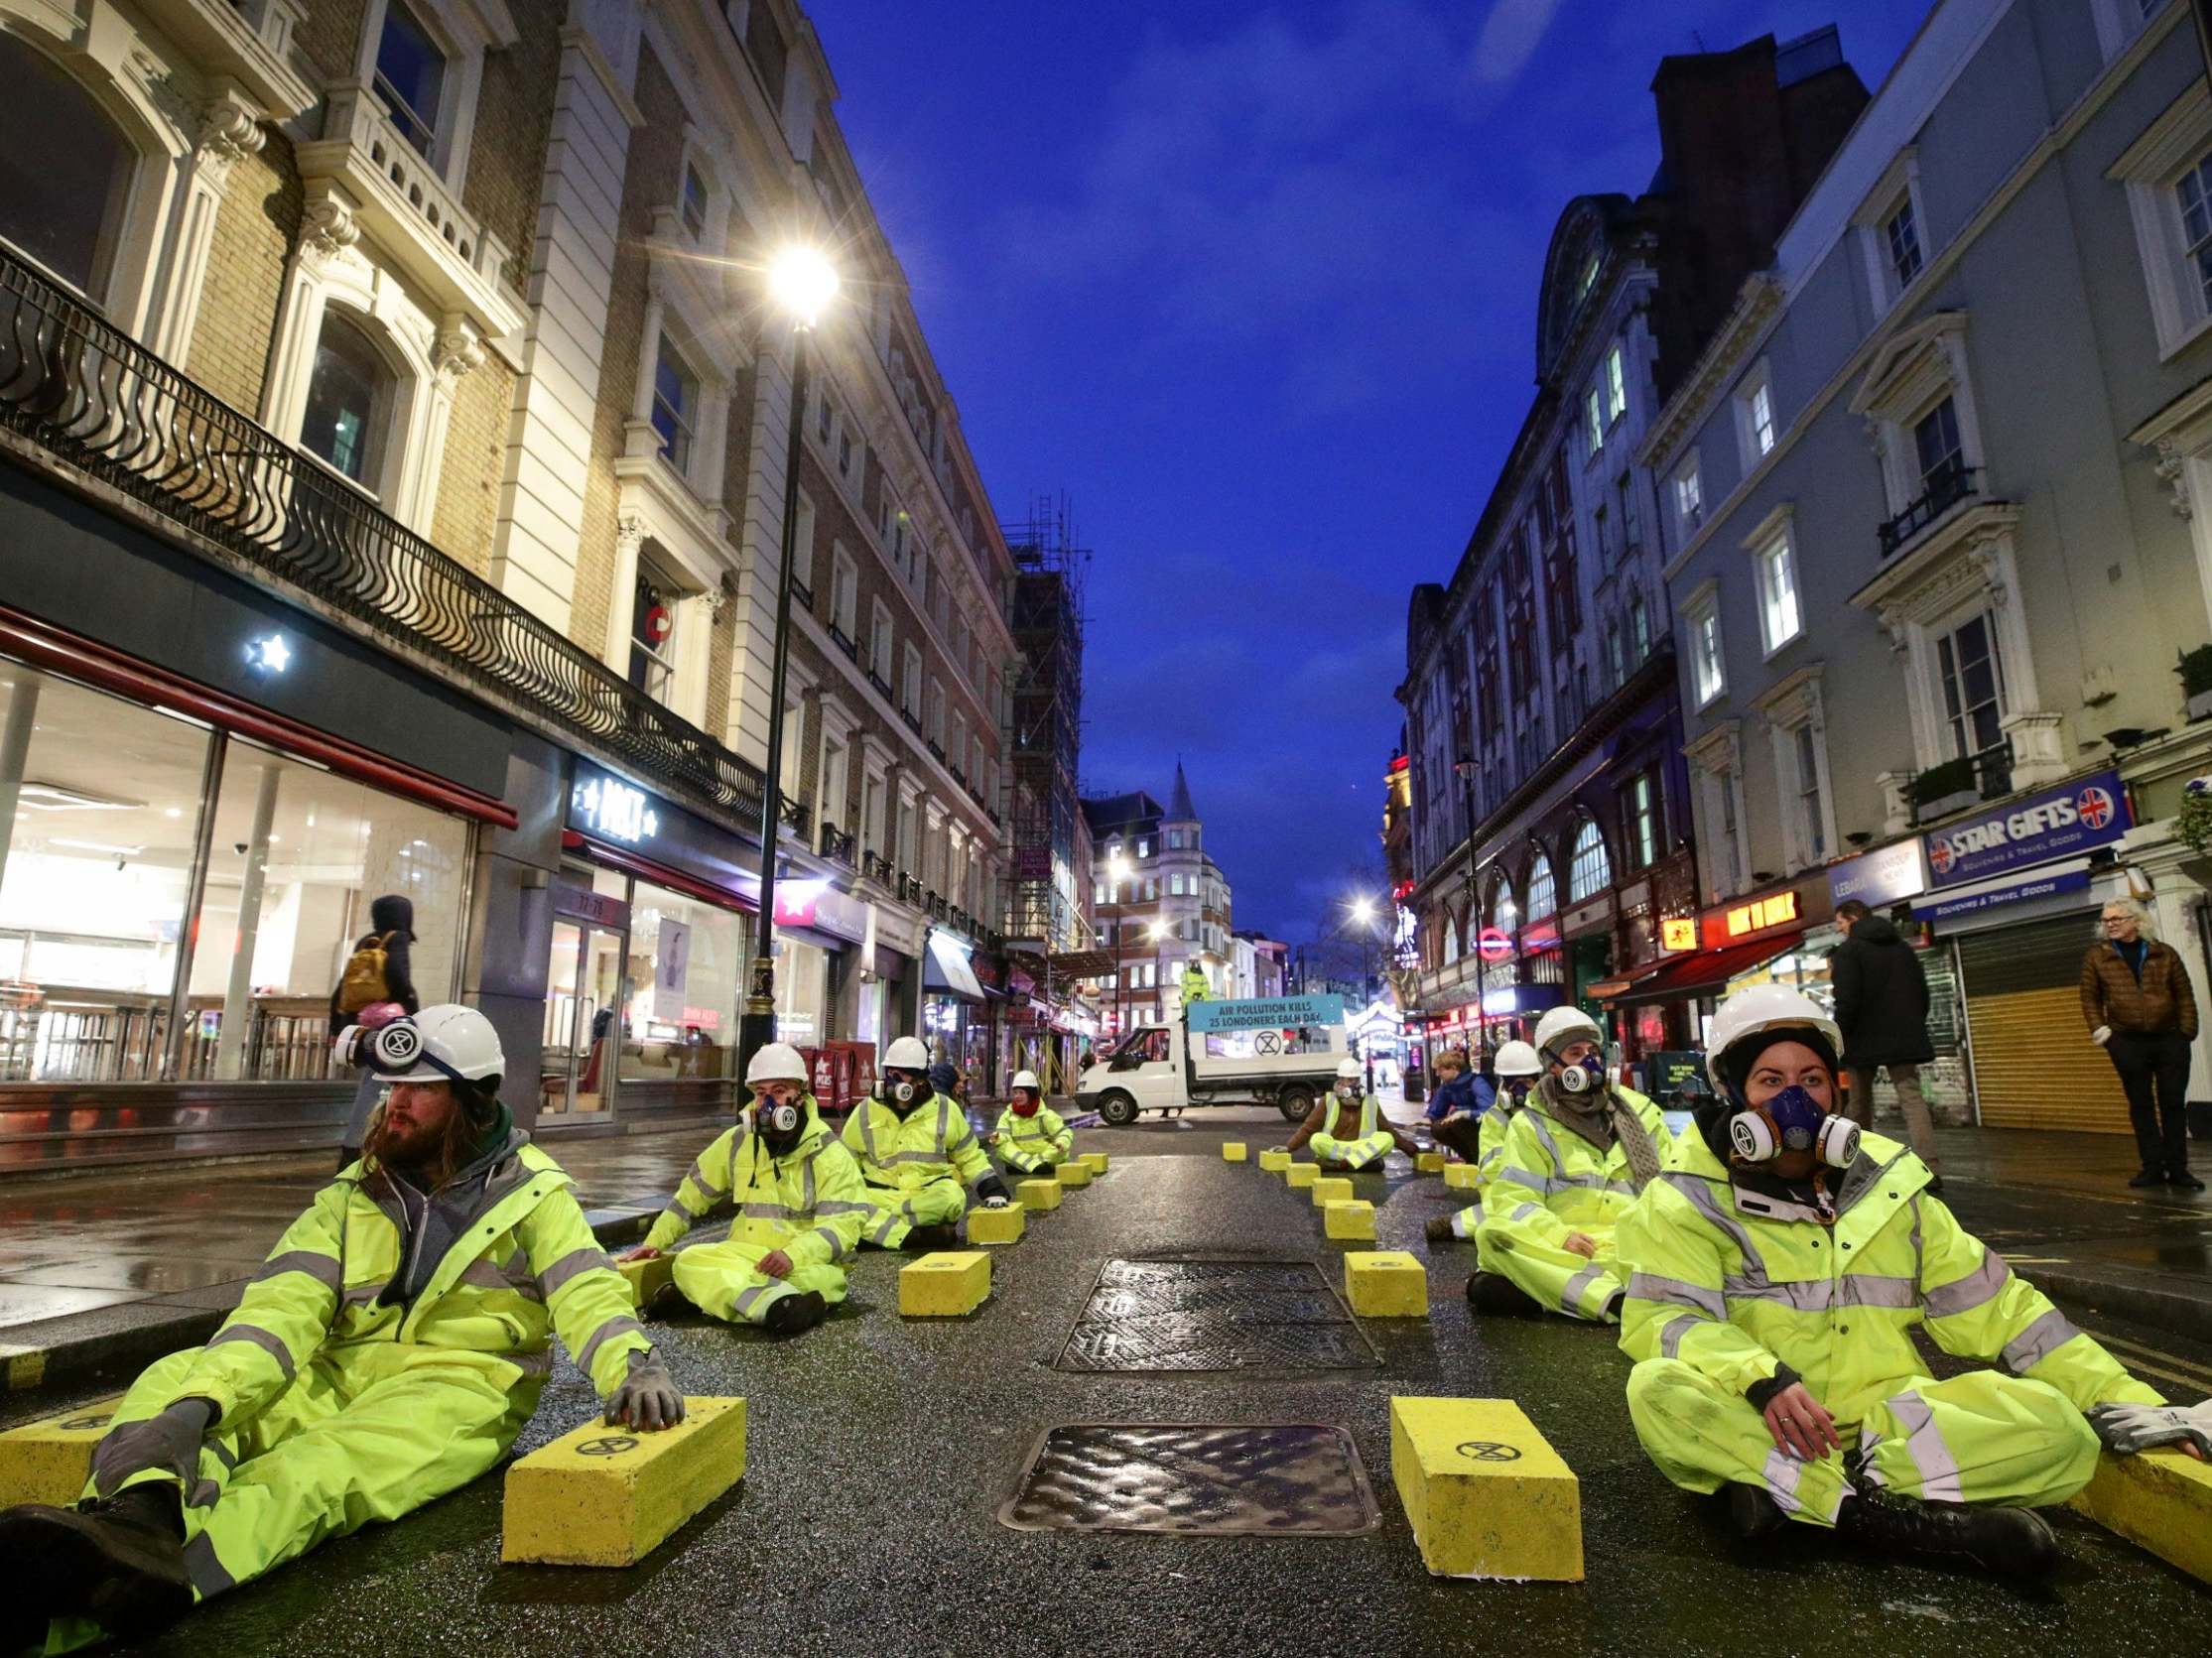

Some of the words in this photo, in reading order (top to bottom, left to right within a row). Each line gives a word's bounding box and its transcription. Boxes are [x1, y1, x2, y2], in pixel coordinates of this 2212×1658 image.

[1952, 822, 2009, 857] STAR
[2008, 797, 2077, 840] GIFTS
[2008, 850, 2015, 859] &
[2049, 831, 2082, 847] GOODS
[1979, 898, 1986, 907] &
[2021, 883, 2056, 897] GOODS
[1219, 1006, 1234, 1016] AIR
[1236, 1003, 1286, 1015] POLLUTION
[1289, 1001, 1312, 1012] KILLS
[1209, 1018, 1220, 1028] 25
[1222, 1015, 1276, 1027] LONDONERS
[1278, 1014, 1301, 1025] EACH
